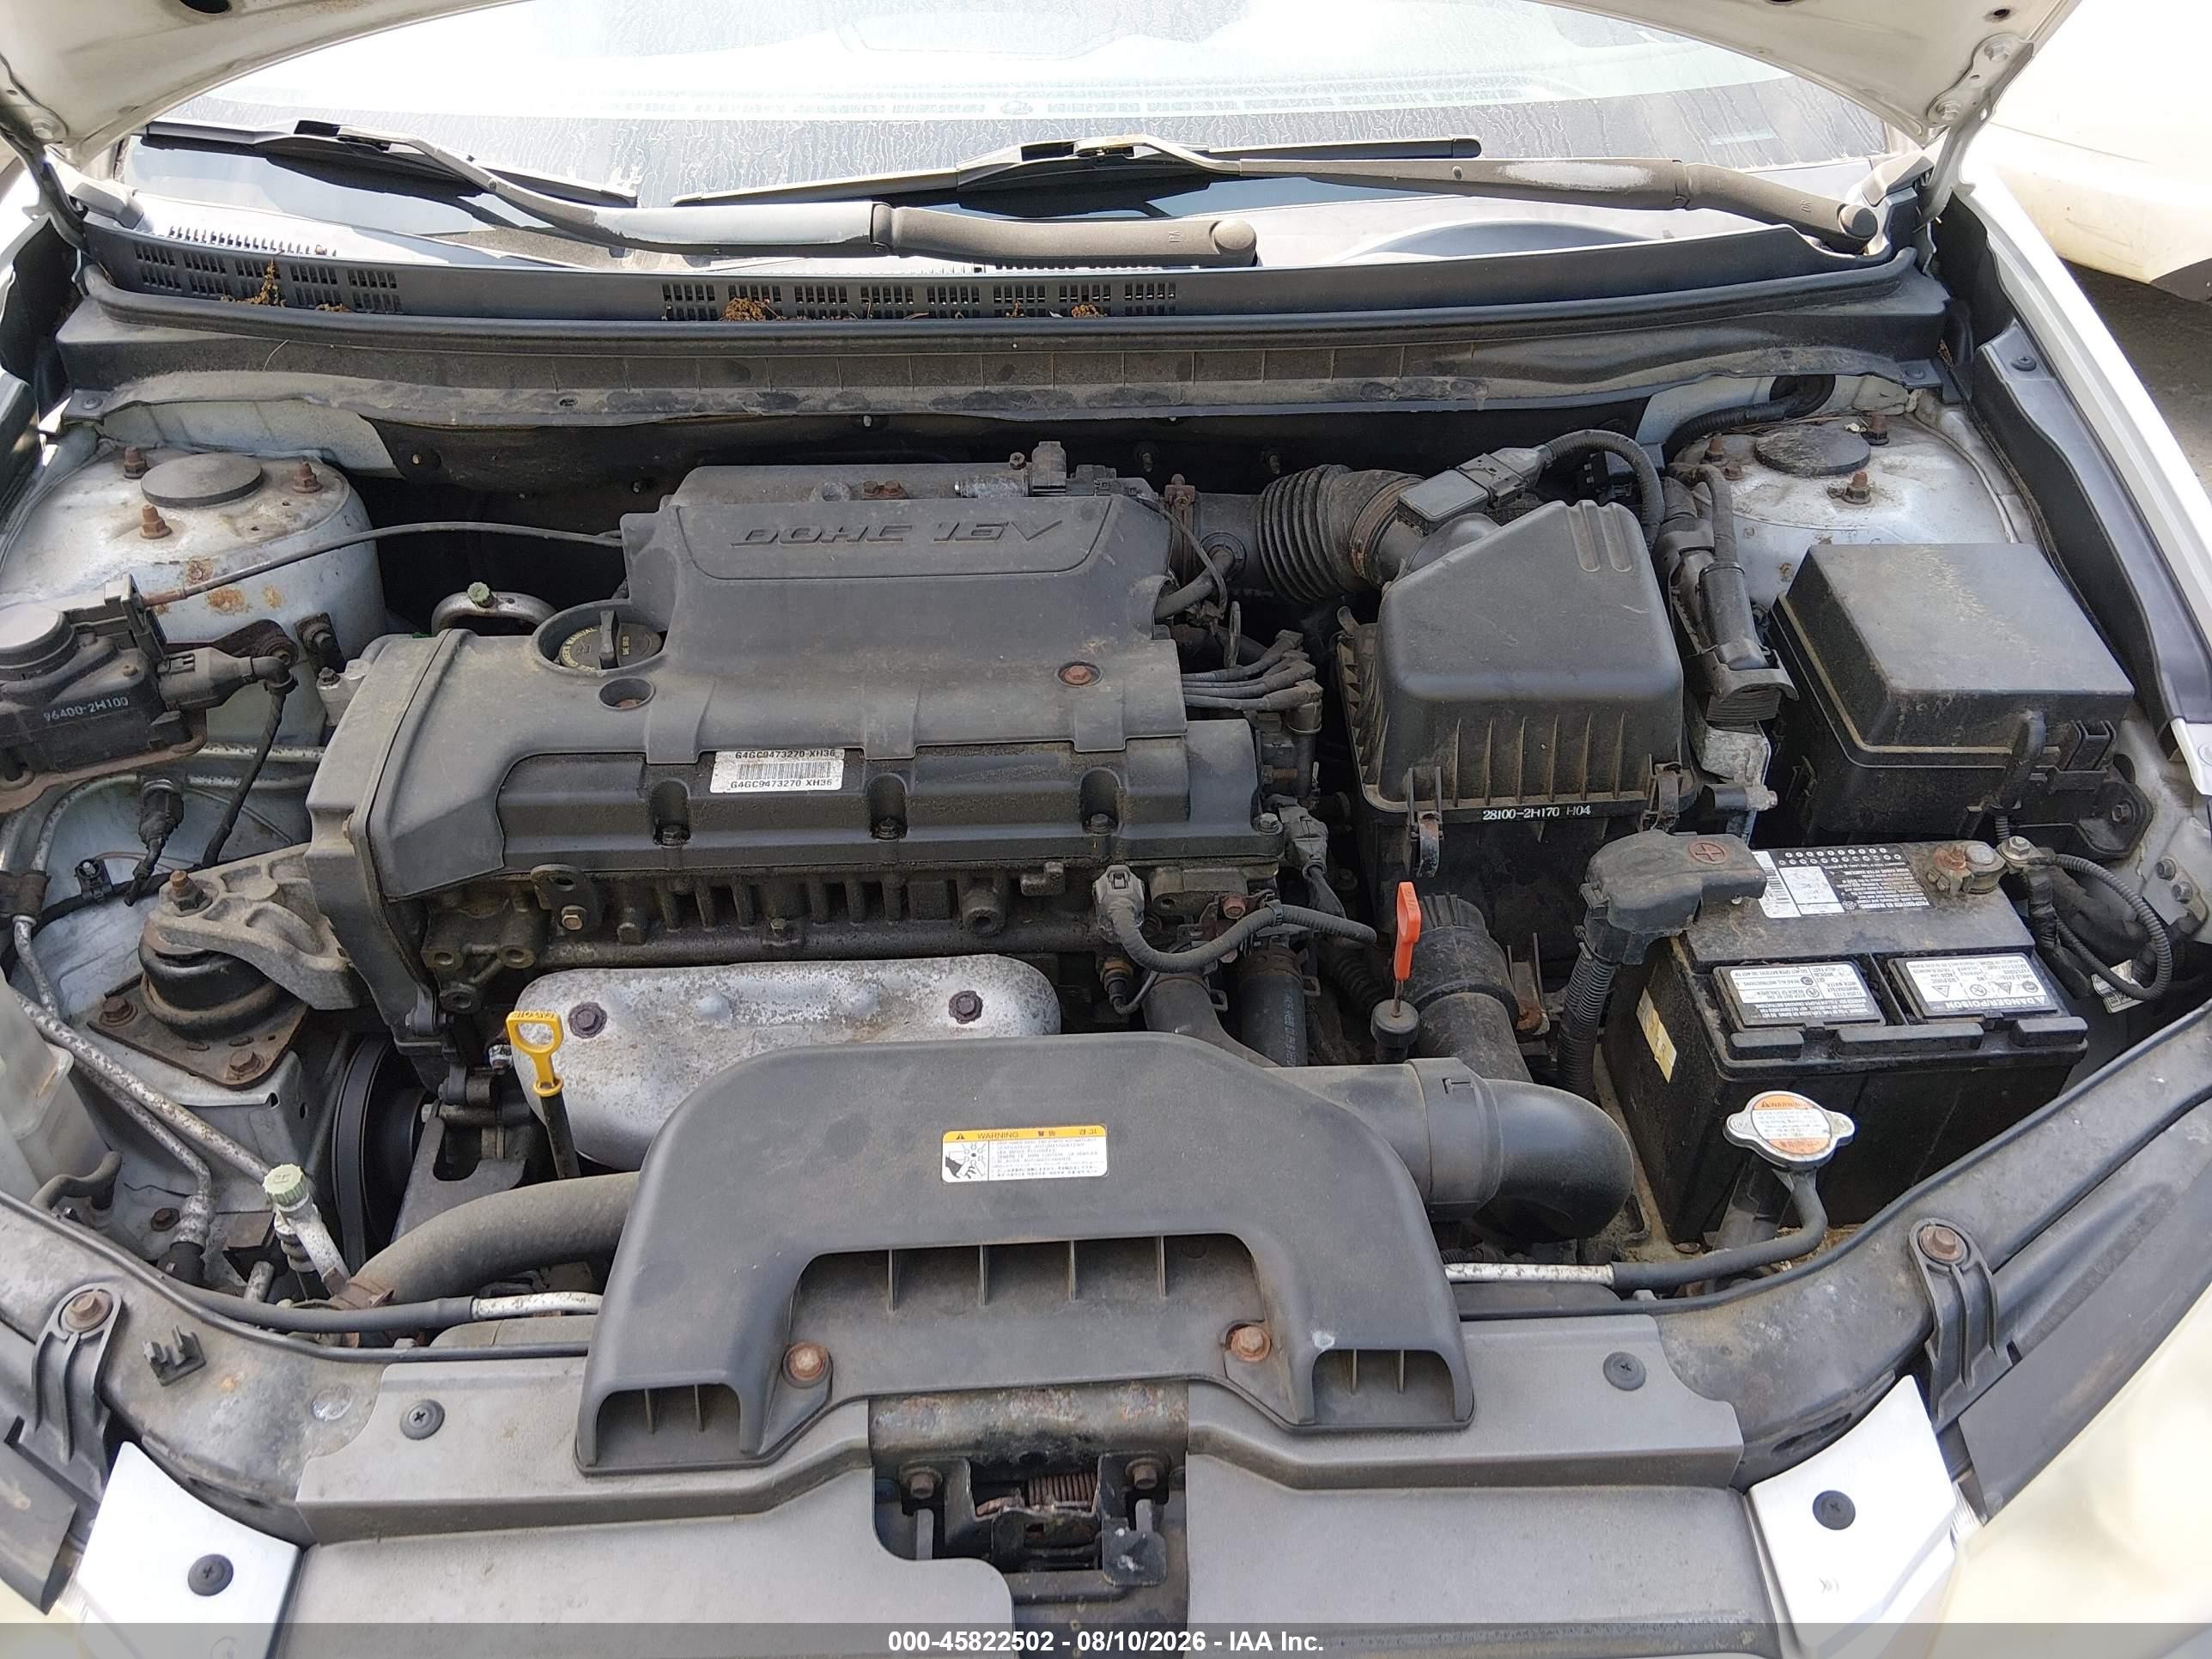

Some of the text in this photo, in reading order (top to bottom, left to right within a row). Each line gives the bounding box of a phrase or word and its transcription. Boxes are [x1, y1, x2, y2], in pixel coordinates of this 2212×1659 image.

[933, 520, 1063, 544] 16V
[43, 696, 129, 721] 96400-2H100
[808, 749, 836, 757] XH36
[730, 778, 833, 789] G4GC9473270 XH36
[1482, 805, 1591, 821] 28100-2H170 H04
[1945, 997, 2035, 1009] DANGER/POISON
